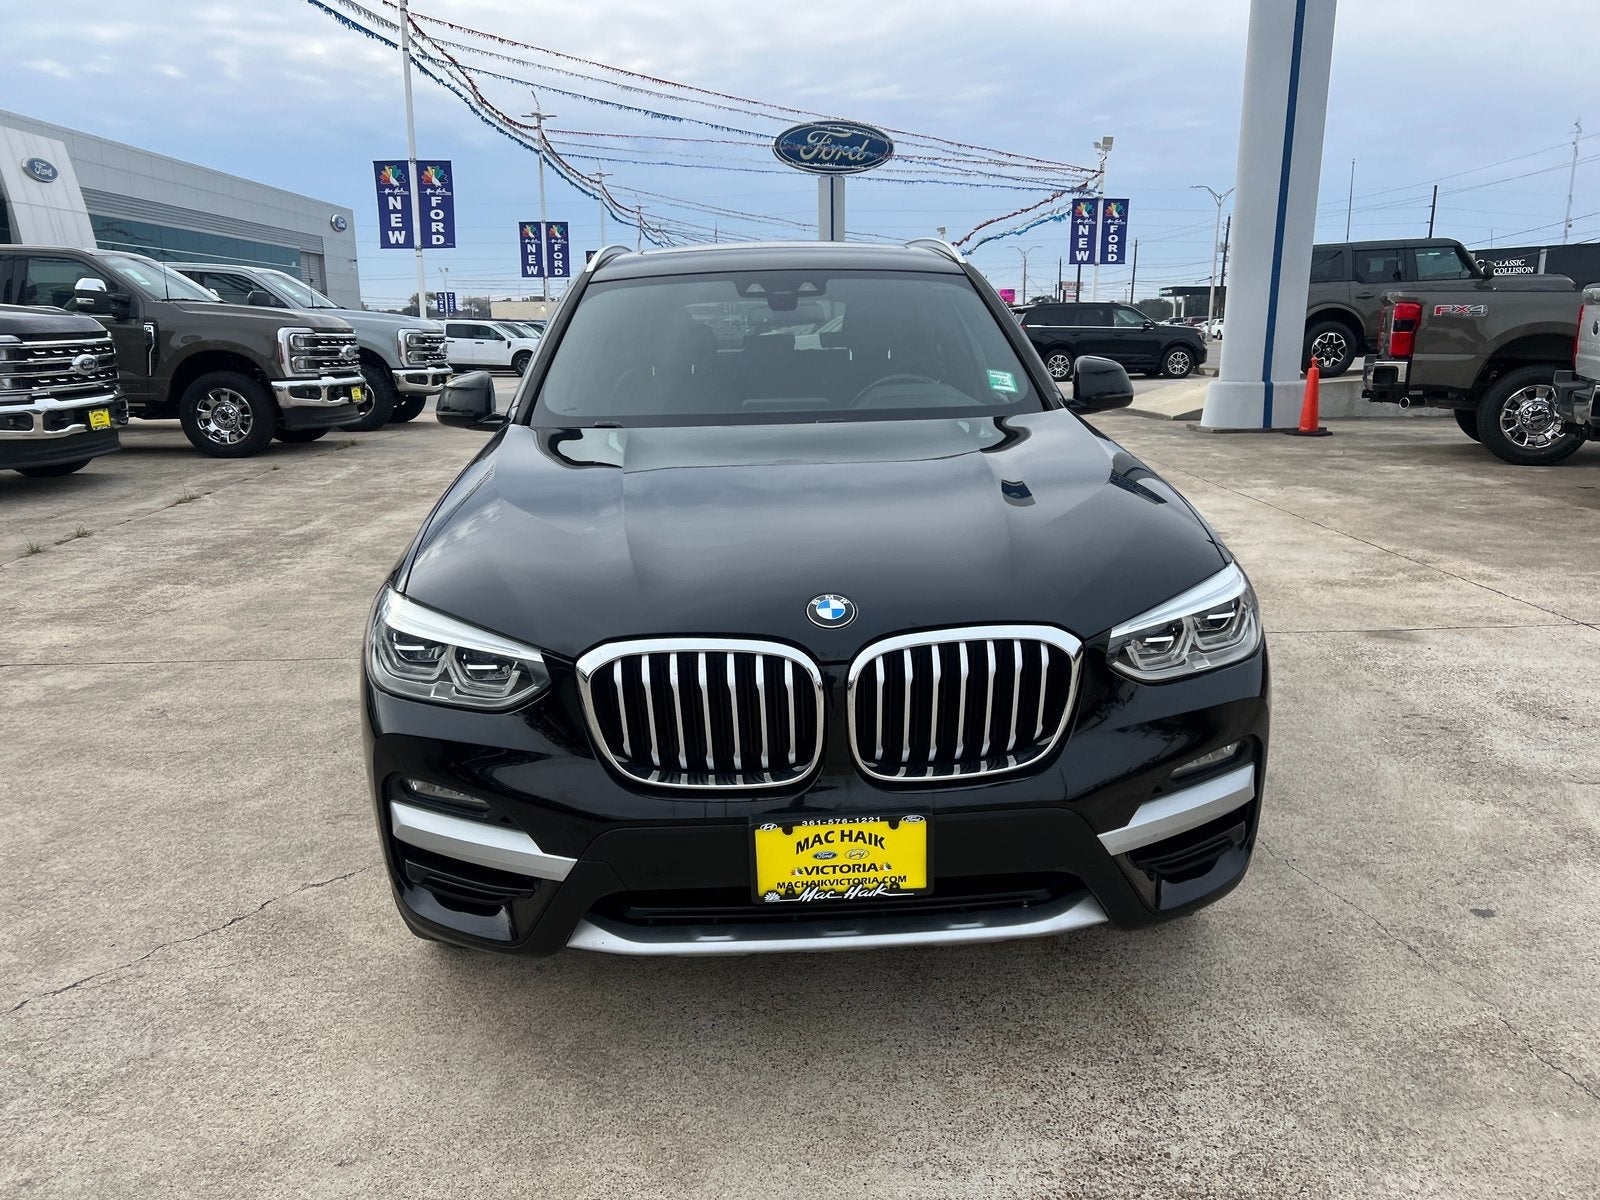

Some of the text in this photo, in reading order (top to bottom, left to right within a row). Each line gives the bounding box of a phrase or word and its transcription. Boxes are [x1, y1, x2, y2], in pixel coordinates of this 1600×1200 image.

[800, 131, 870, 160] Ford
[388, 196, 406, 245] NEW
[430, 196, 445, 245] FORD
[1075, 225, 1090, 261] NEW
[1107, 225, 1119, 262] FORD
[526, 244, 538, 274] NEW
[553, 244, 563, 275] FORD
[1493, 266, 1535, 274] COLLISION
[1494, 259, 1526, 267] CLASSIC
[1434, 304, 1487, 316] FX4
[802, 816, 881, 826] 361-576-1221
[796, 830, 886, 855] MAC HAIK
[816, 852, 834, 860] Ford
[804, 862, 879, 876] VICTORIA
[776, 875, 907, 889] MACHAIKVICTORIA.COM
[799, 883, 890, 902] Mac Haik
